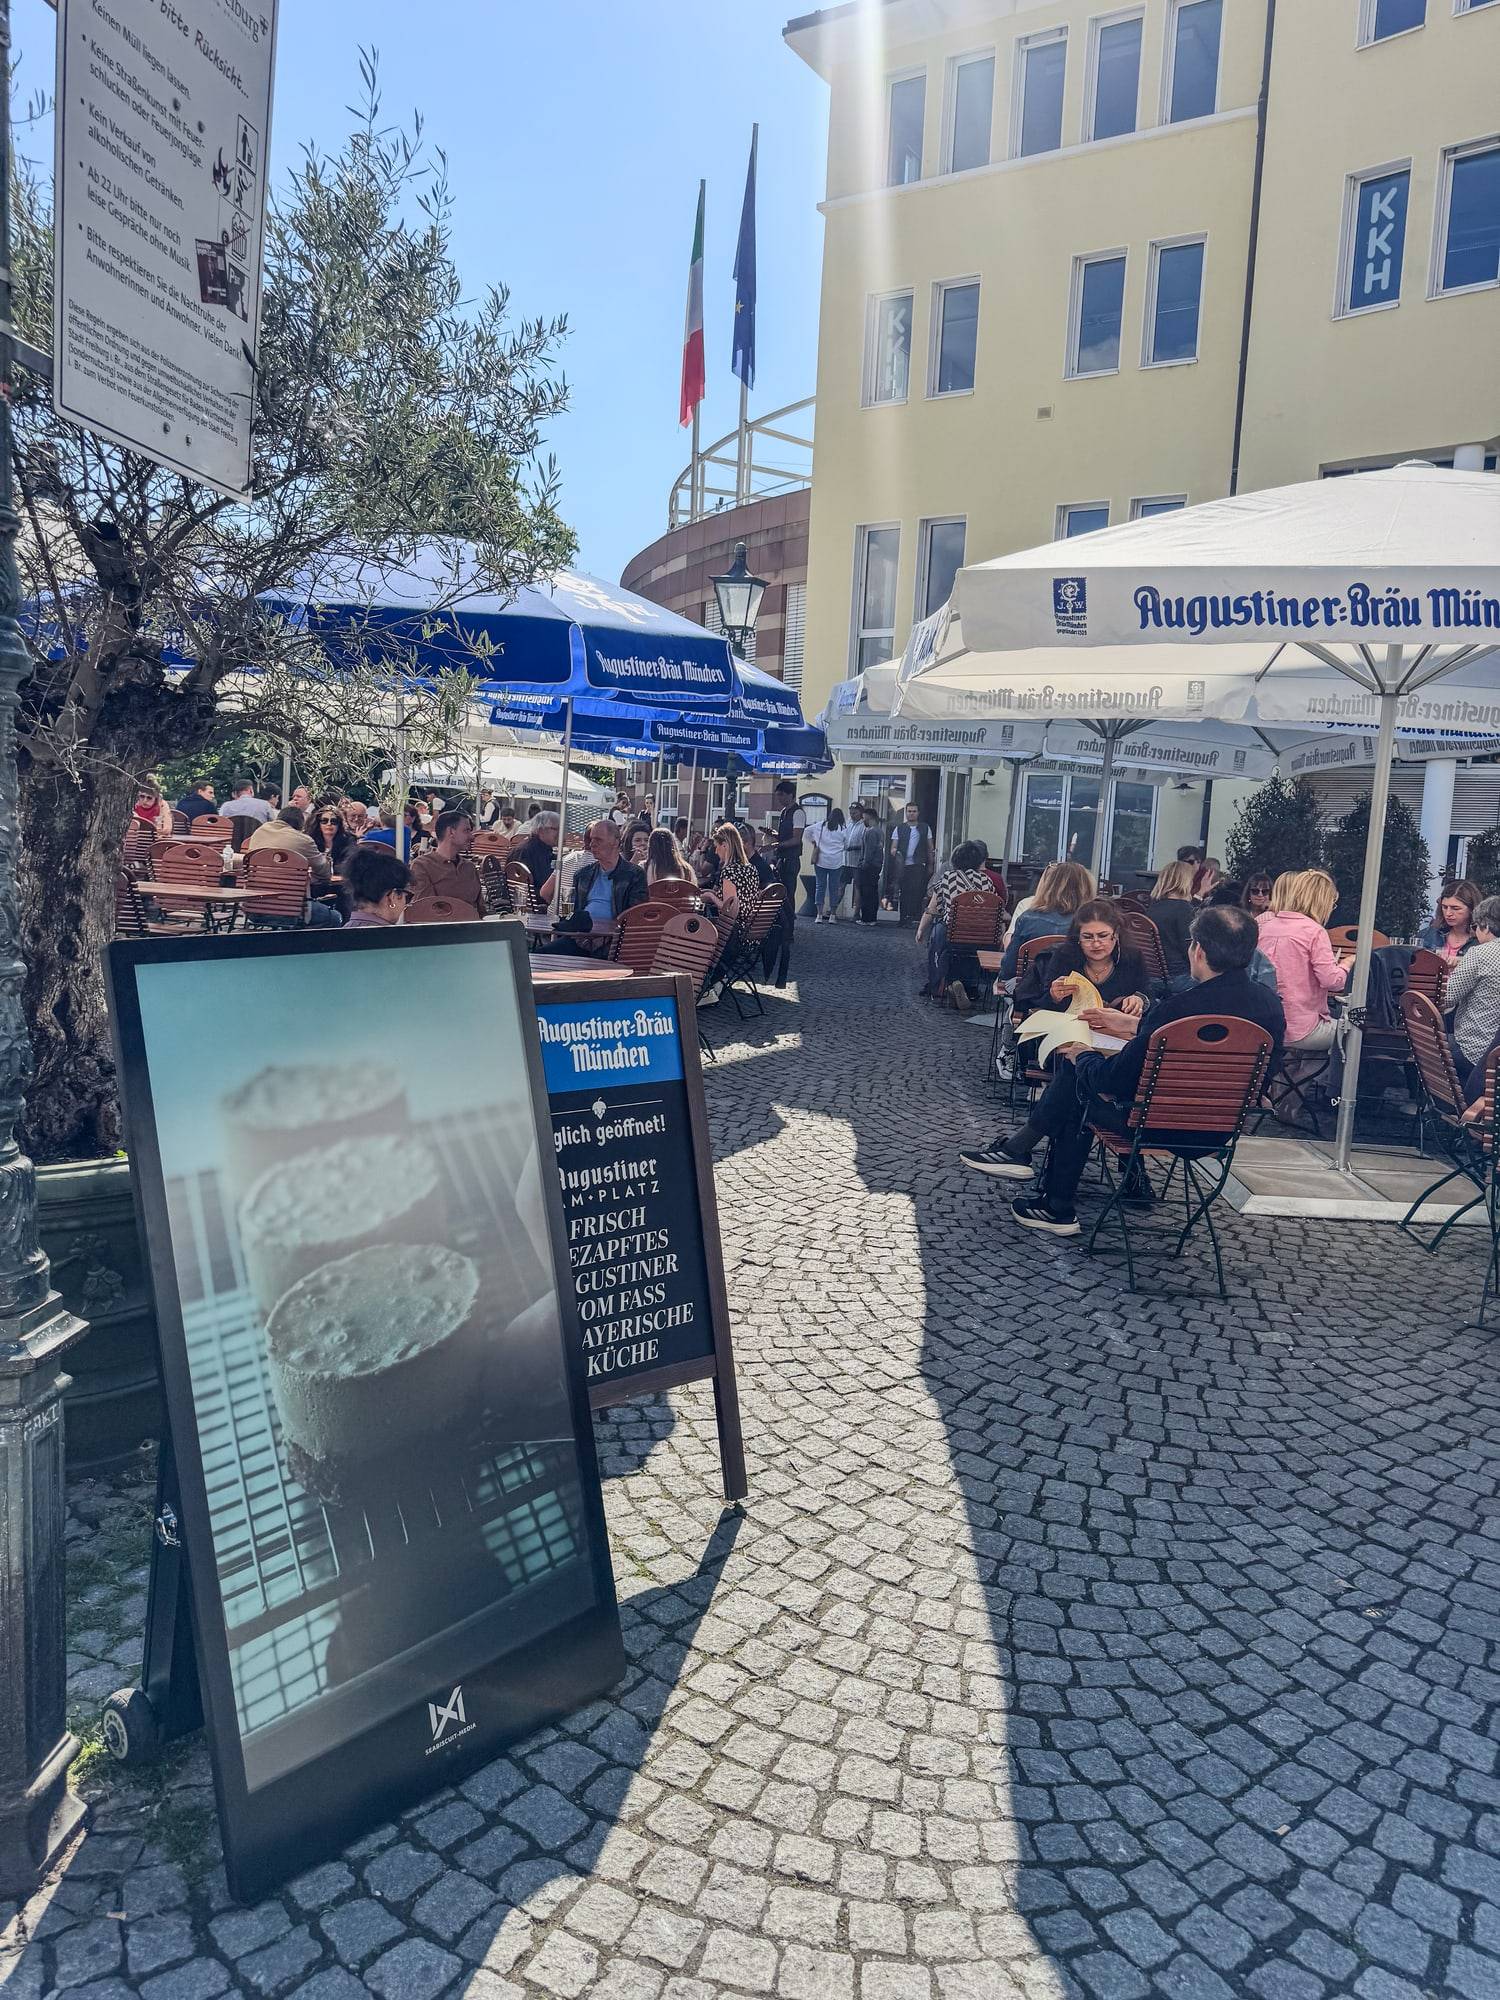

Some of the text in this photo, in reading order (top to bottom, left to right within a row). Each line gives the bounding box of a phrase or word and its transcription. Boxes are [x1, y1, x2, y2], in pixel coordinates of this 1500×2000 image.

[160, 0, 189, 37] bitte
[123, 26, 141, 53] Müll
[142, 44, 165, 77] liegen
[167, 67, 191, 100] lassen.
[90, 39, 206, 152] Keine Straßenkunst mit Feuer-
[90, 63, 203, 169] schlucken oder Feuerjonglage.
[89, 102, 156, 168] Kein Verkauf von
[88, 126, 184, 211] alkoholischen Getränken.
[88, 166, 181, 246] Ab 22 Uhr bitte nur noch
[88, 184, 106, 210] leise
[108, 201, 148, 242] Gespräche
[149, 234, 168, 255] ohne
[169, 247, 191, 272] Musik.
[1364, 187, 1398, 294] KKH
[86, 248, 242, 361] Anwohnerinnen und Anwohner. Vielen Dank!
[87, 226, 227, 333] Bitte respektieren Sie die Nachtruhe der
[682, 660, 725, 682] München
[720, 732, 751, 745] München
[569, 1041, 650, 1073] München
[596, 1114, 666, 1147] geöffnet!
[570, 1206, 646, 1241] FRISCH
[574, 1253, 680, 1294] GUSTINER
[619, 1282, 666, 1313] FASS
[586, 1338, 660, 1378] KÜCHE
[425, 1722, 477, 1756] SEABISCUIT-MEDIA
